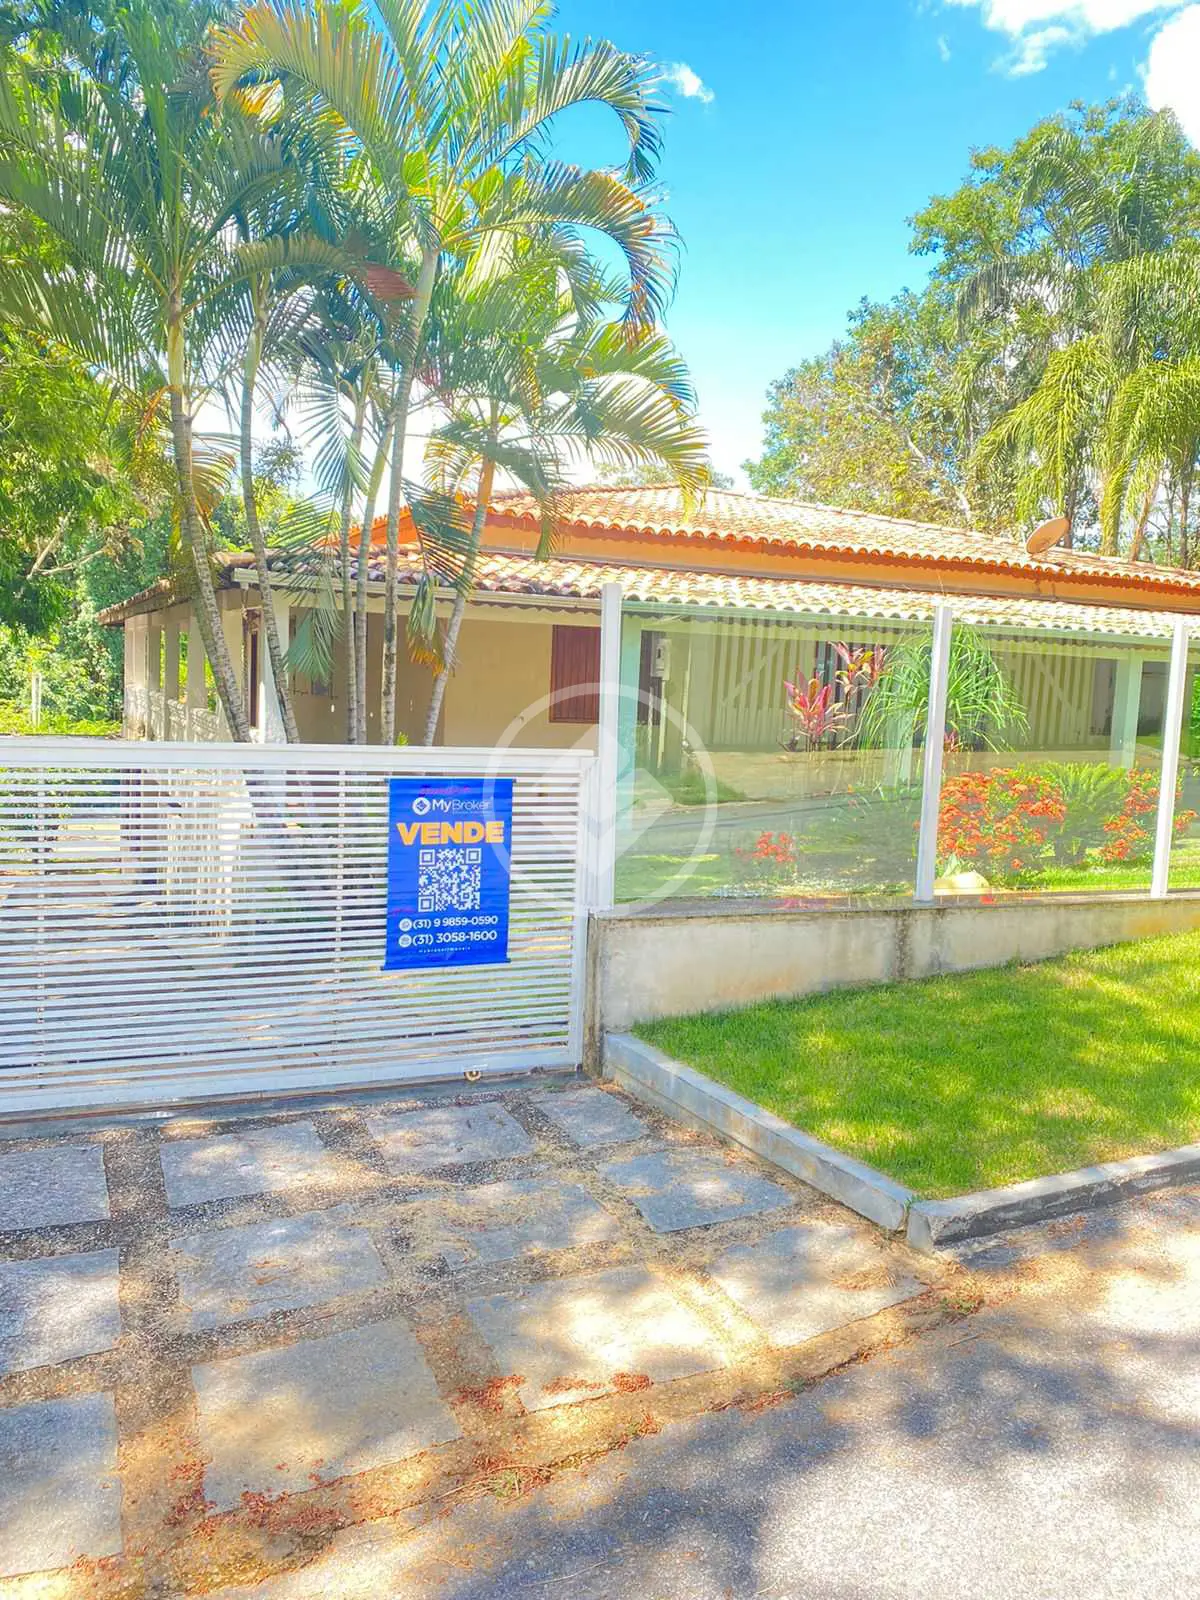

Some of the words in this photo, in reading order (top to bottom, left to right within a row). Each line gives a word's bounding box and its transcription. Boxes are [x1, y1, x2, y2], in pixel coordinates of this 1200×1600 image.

[432, 799, 490, 812] MyBroker
[396, 821, 504, 846] VENDE
[412, 919, 432, 930] (31)
[433, 918, 441, 927] 9
[442, 915, 499, 926] 9859-0590
[412, 934, 434, 946] (31)
[436, 930, 498, 943] 3058-1600
